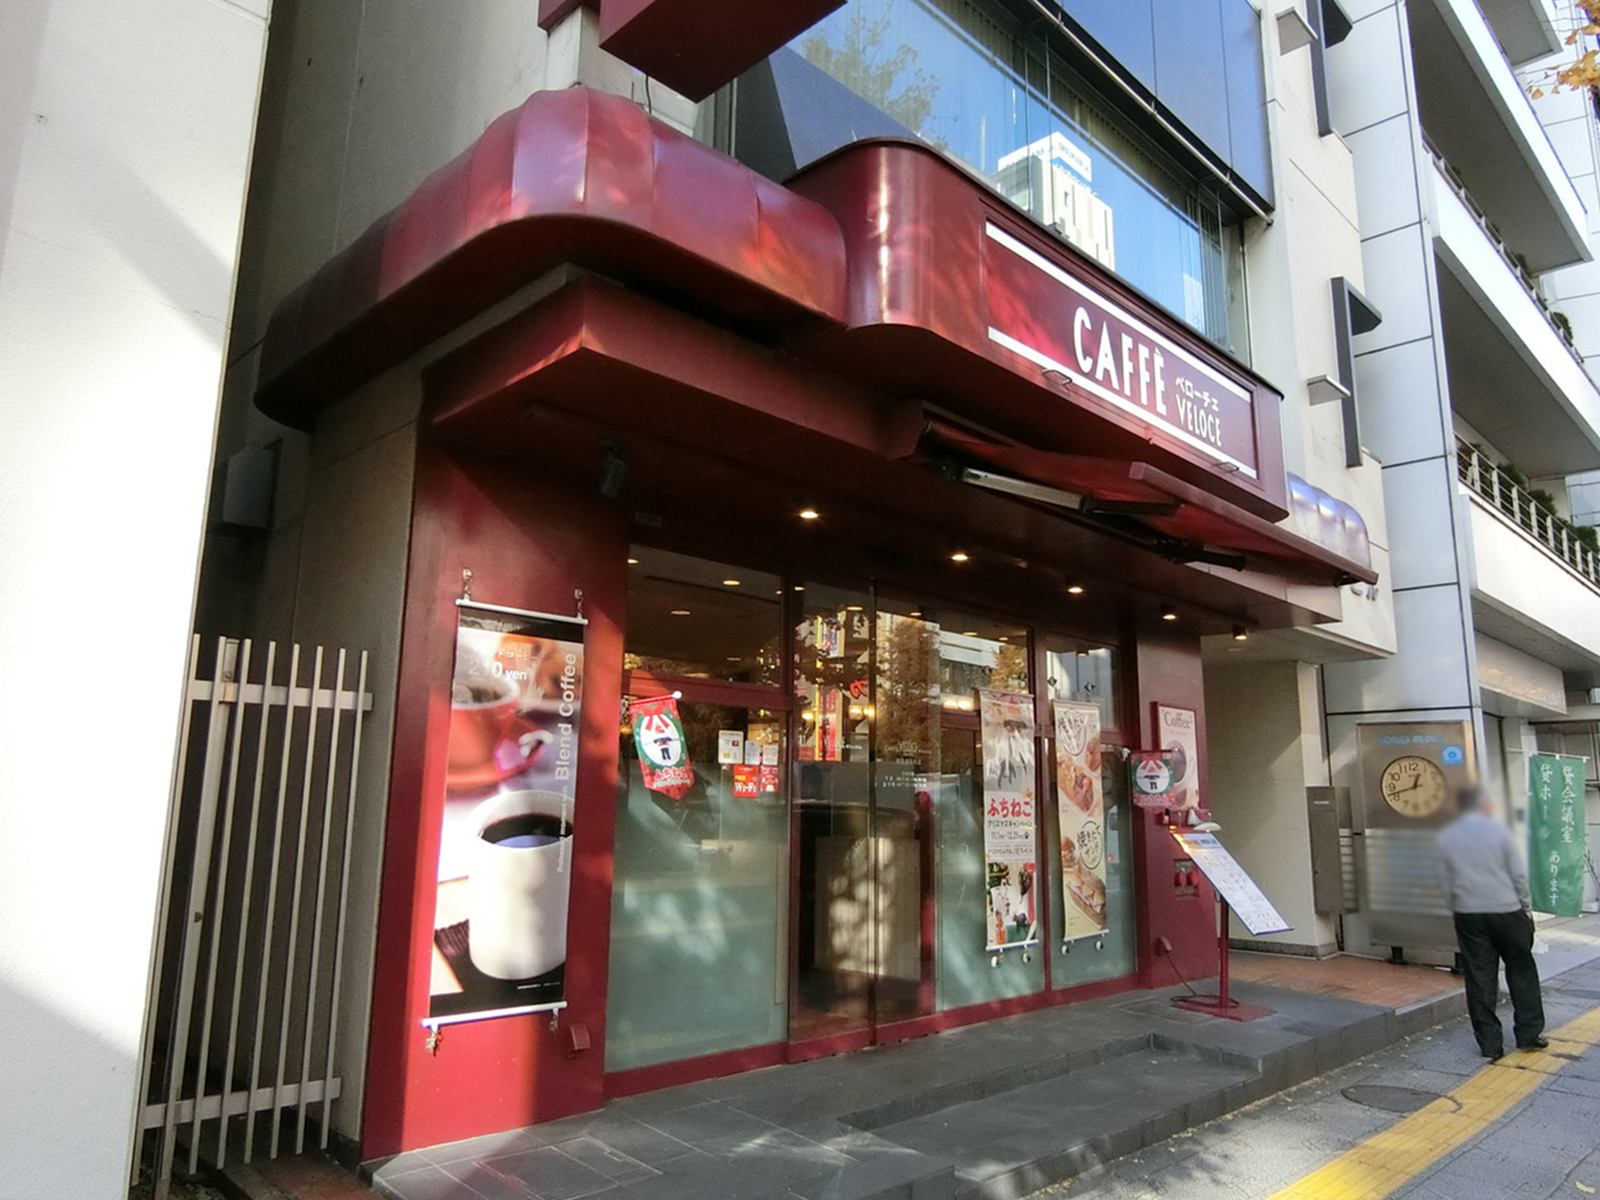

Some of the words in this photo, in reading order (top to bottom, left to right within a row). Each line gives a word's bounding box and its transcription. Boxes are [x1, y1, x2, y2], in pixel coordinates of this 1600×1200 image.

[1073, 306, 1167, 416] CAFFÈ
[1175, 376, 1220, 413] ベローチェ
[1176, 394, 1222, 447] VELOCE
[505, 669, 528, 681] yen
[559, 653, 577, 717] Coffee
[1164, 710, 1192, 730] Coffee
[555, 723, 572, 781] Blend
[1388, 772, 1401, 782] 10
[1397, 762, 1408, 774] 11
[1409, 762, 1419, 771] 12
[734, 781, 757, 793] Wi-Fi
[1388, 782, 1396, 792] 9
[1393, 792, 1401, 801] 8
[987, 797, 1033, 818] ふちねこ
[1560, 765, 1577, 843] 貸会議室
[560, 803, 568, 835] moment
[1549, 849, 1560, 906] あります
